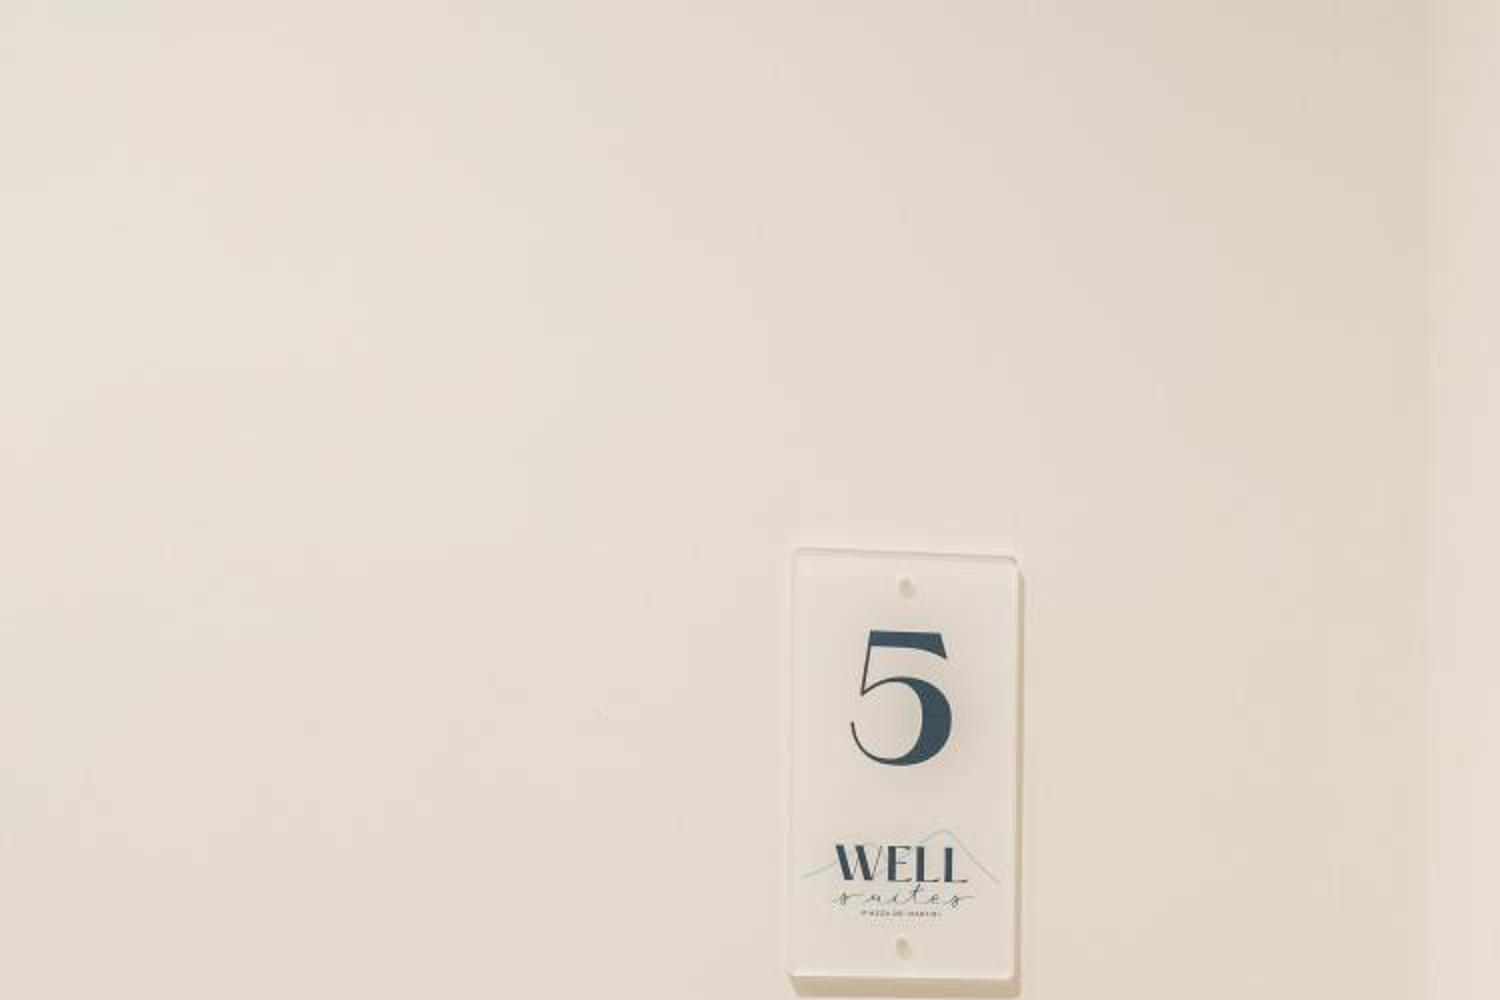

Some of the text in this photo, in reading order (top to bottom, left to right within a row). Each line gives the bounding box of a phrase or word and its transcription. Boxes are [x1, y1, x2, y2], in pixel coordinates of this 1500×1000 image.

[849, 629, 953, 767] 5
[835, 844, 968, 883] WELL
[832, 882, 976, 909] suites
